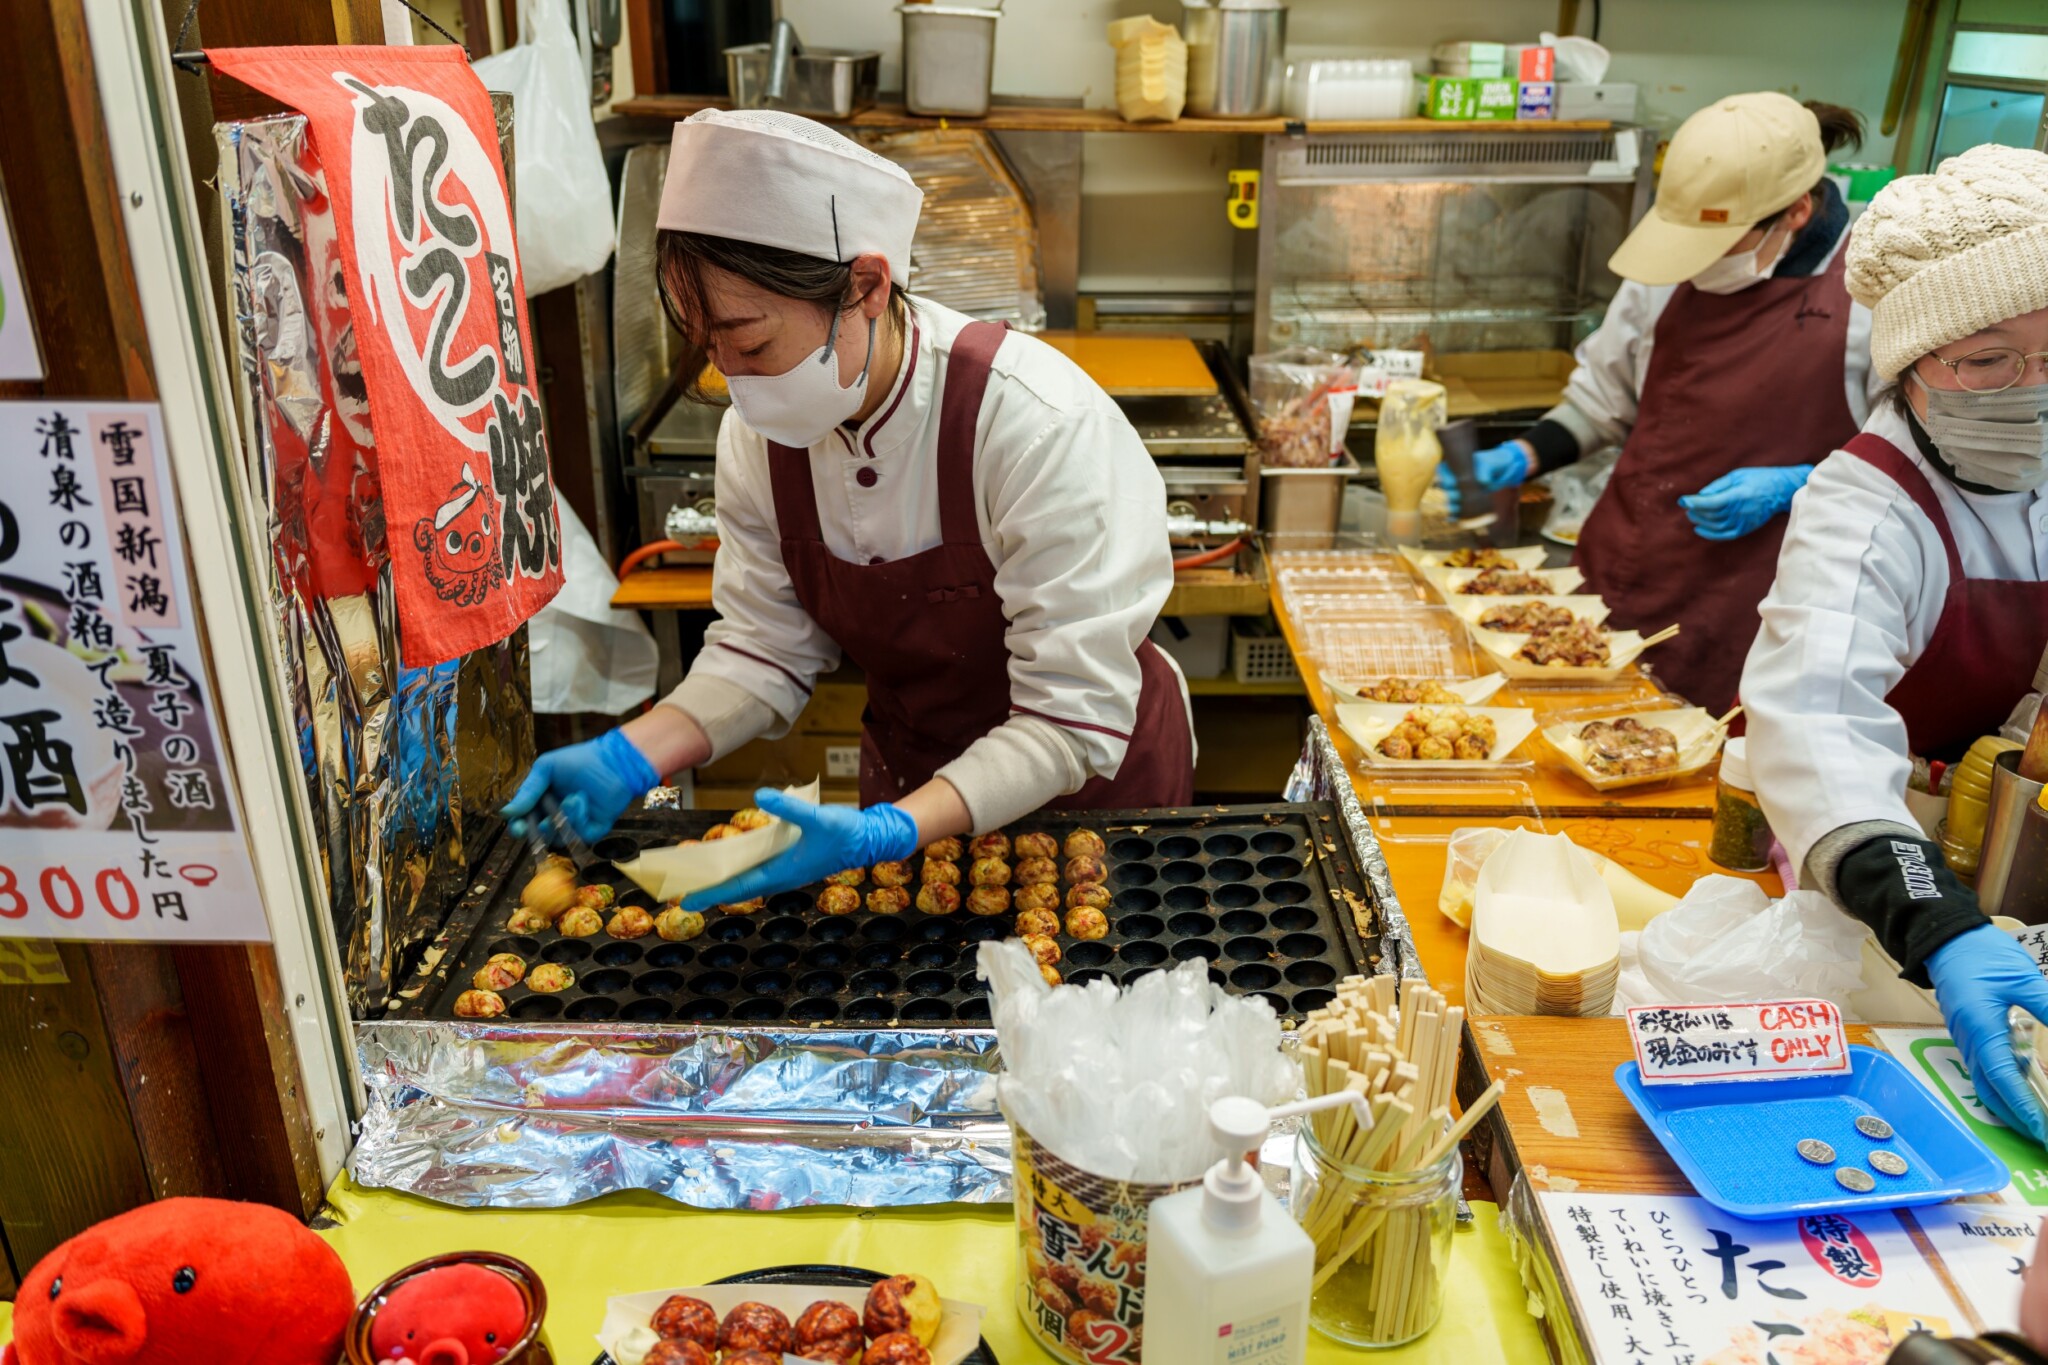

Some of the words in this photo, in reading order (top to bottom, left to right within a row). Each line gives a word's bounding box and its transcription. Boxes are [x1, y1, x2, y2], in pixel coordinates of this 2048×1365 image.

[492, 260, 524, 376] 名物
[34, 411, 173, 880] 清泉の酒粕で造りました
[100, 421, 169, 617] 雪国新潟
[138, 643, 212, 806] 夏子の酒
[1637, 1009, 1734, 1035] お支払いは
[1758, 1003, 1831, 1031] CASH
[1644, 1036, 1759, 1069] 現金のみです
[1770, 1033, 1832, 1064] ONLY
[1649, 1210, 1708, 1304] ひとつひとつ
[1805, 1213, 1879, 1279] 特製
[1957, 1221, 2036, 1238] Mustard
